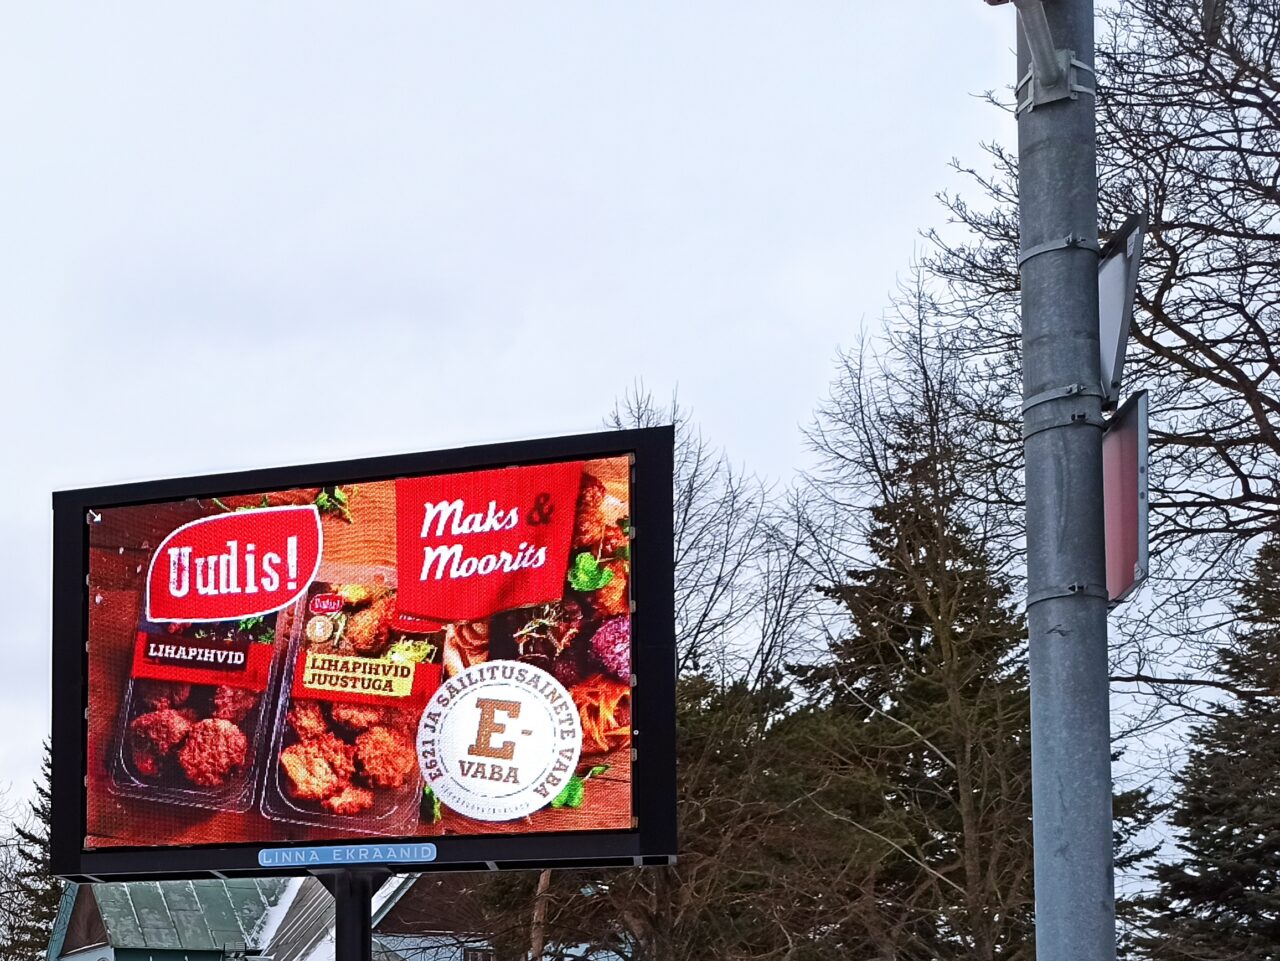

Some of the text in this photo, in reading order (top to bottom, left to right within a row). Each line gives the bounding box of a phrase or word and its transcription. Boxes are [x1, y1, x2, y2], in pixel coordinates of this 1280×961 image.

[420, 492, 554, 538] Maks &
[167, 535, 298, 598] Uudis!
[420, 541, 548, 581] Moorits
[148, 643, 245, 665] LIHAPIHVID
[310, 658, 411, 678] LIHAPIHVID
[308, 673, 394, 692] JUUSTUGA
[437, 665, 576, 741] SÄILITUSAINETE
[424, 711, 442, 734] JA
[422, 738, 443, 781] E621
[458, 760, 520, 784] VABA
[532, 746, 575, 799] VABA
[263, 846, 432, 864] LINNA EKRAANID
